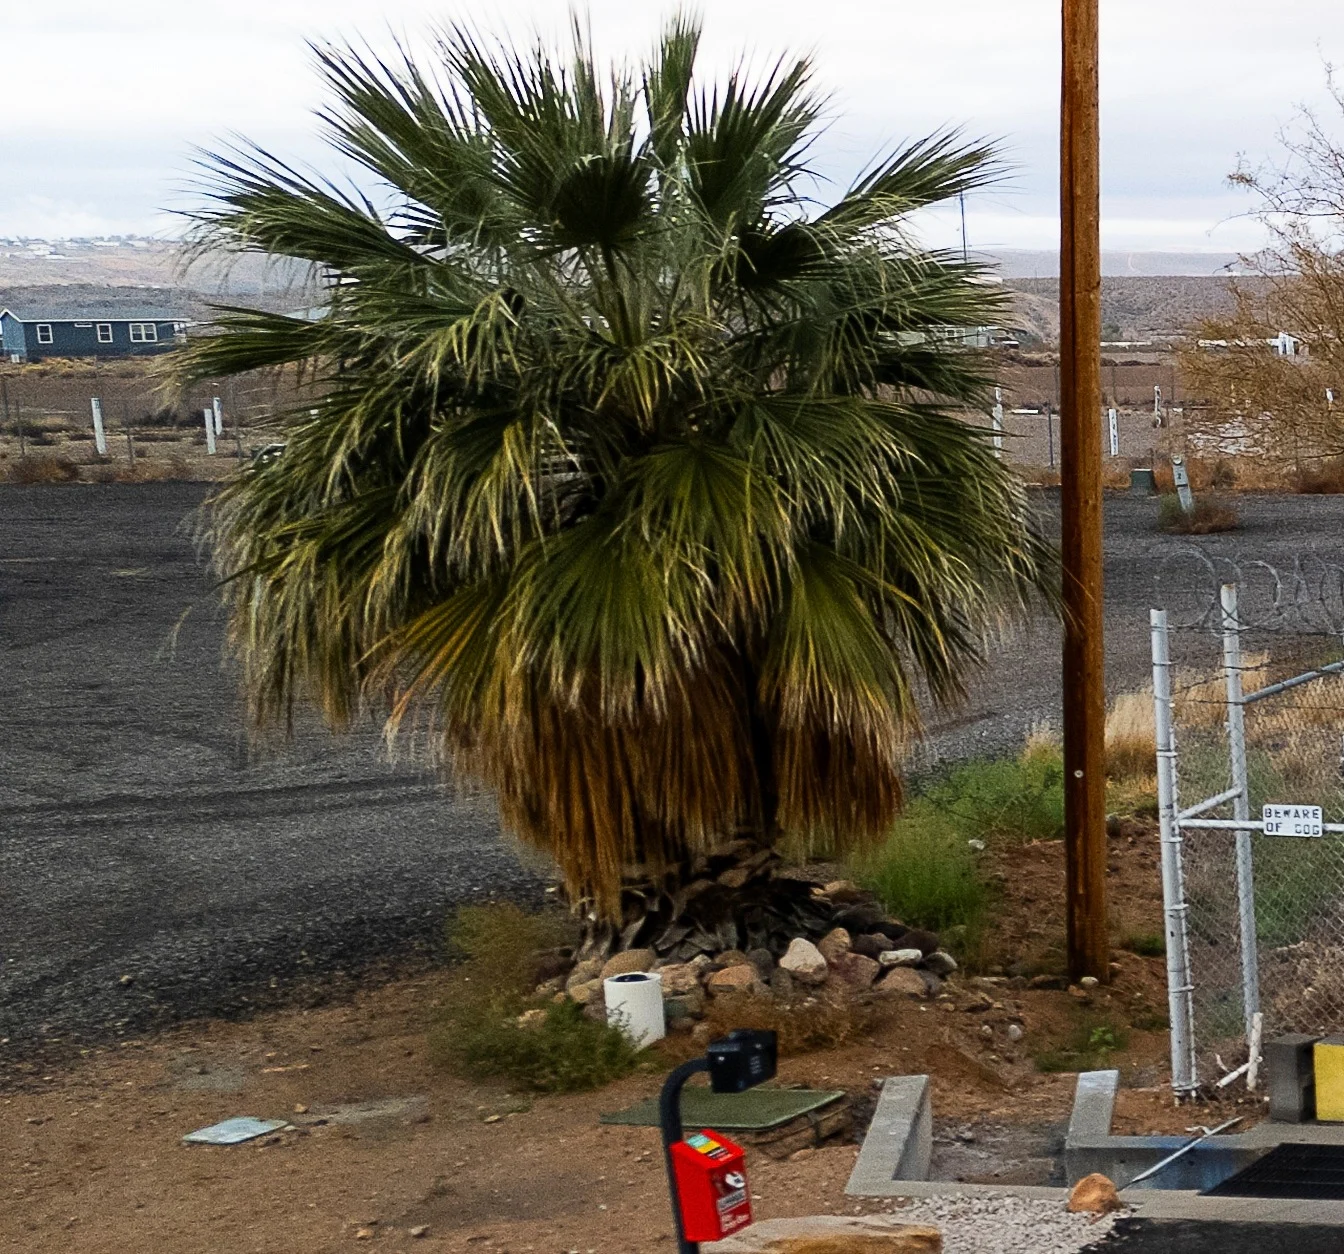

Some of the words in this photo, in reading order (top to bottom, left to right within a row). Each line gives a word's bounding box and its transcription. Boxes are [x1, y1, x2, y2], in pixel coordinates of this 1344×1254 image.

[1264, 808, 1320, 819] BEWARE
[1266, 822, 1283, 832] OF
[1294, 824, 1320, 835] DOG
